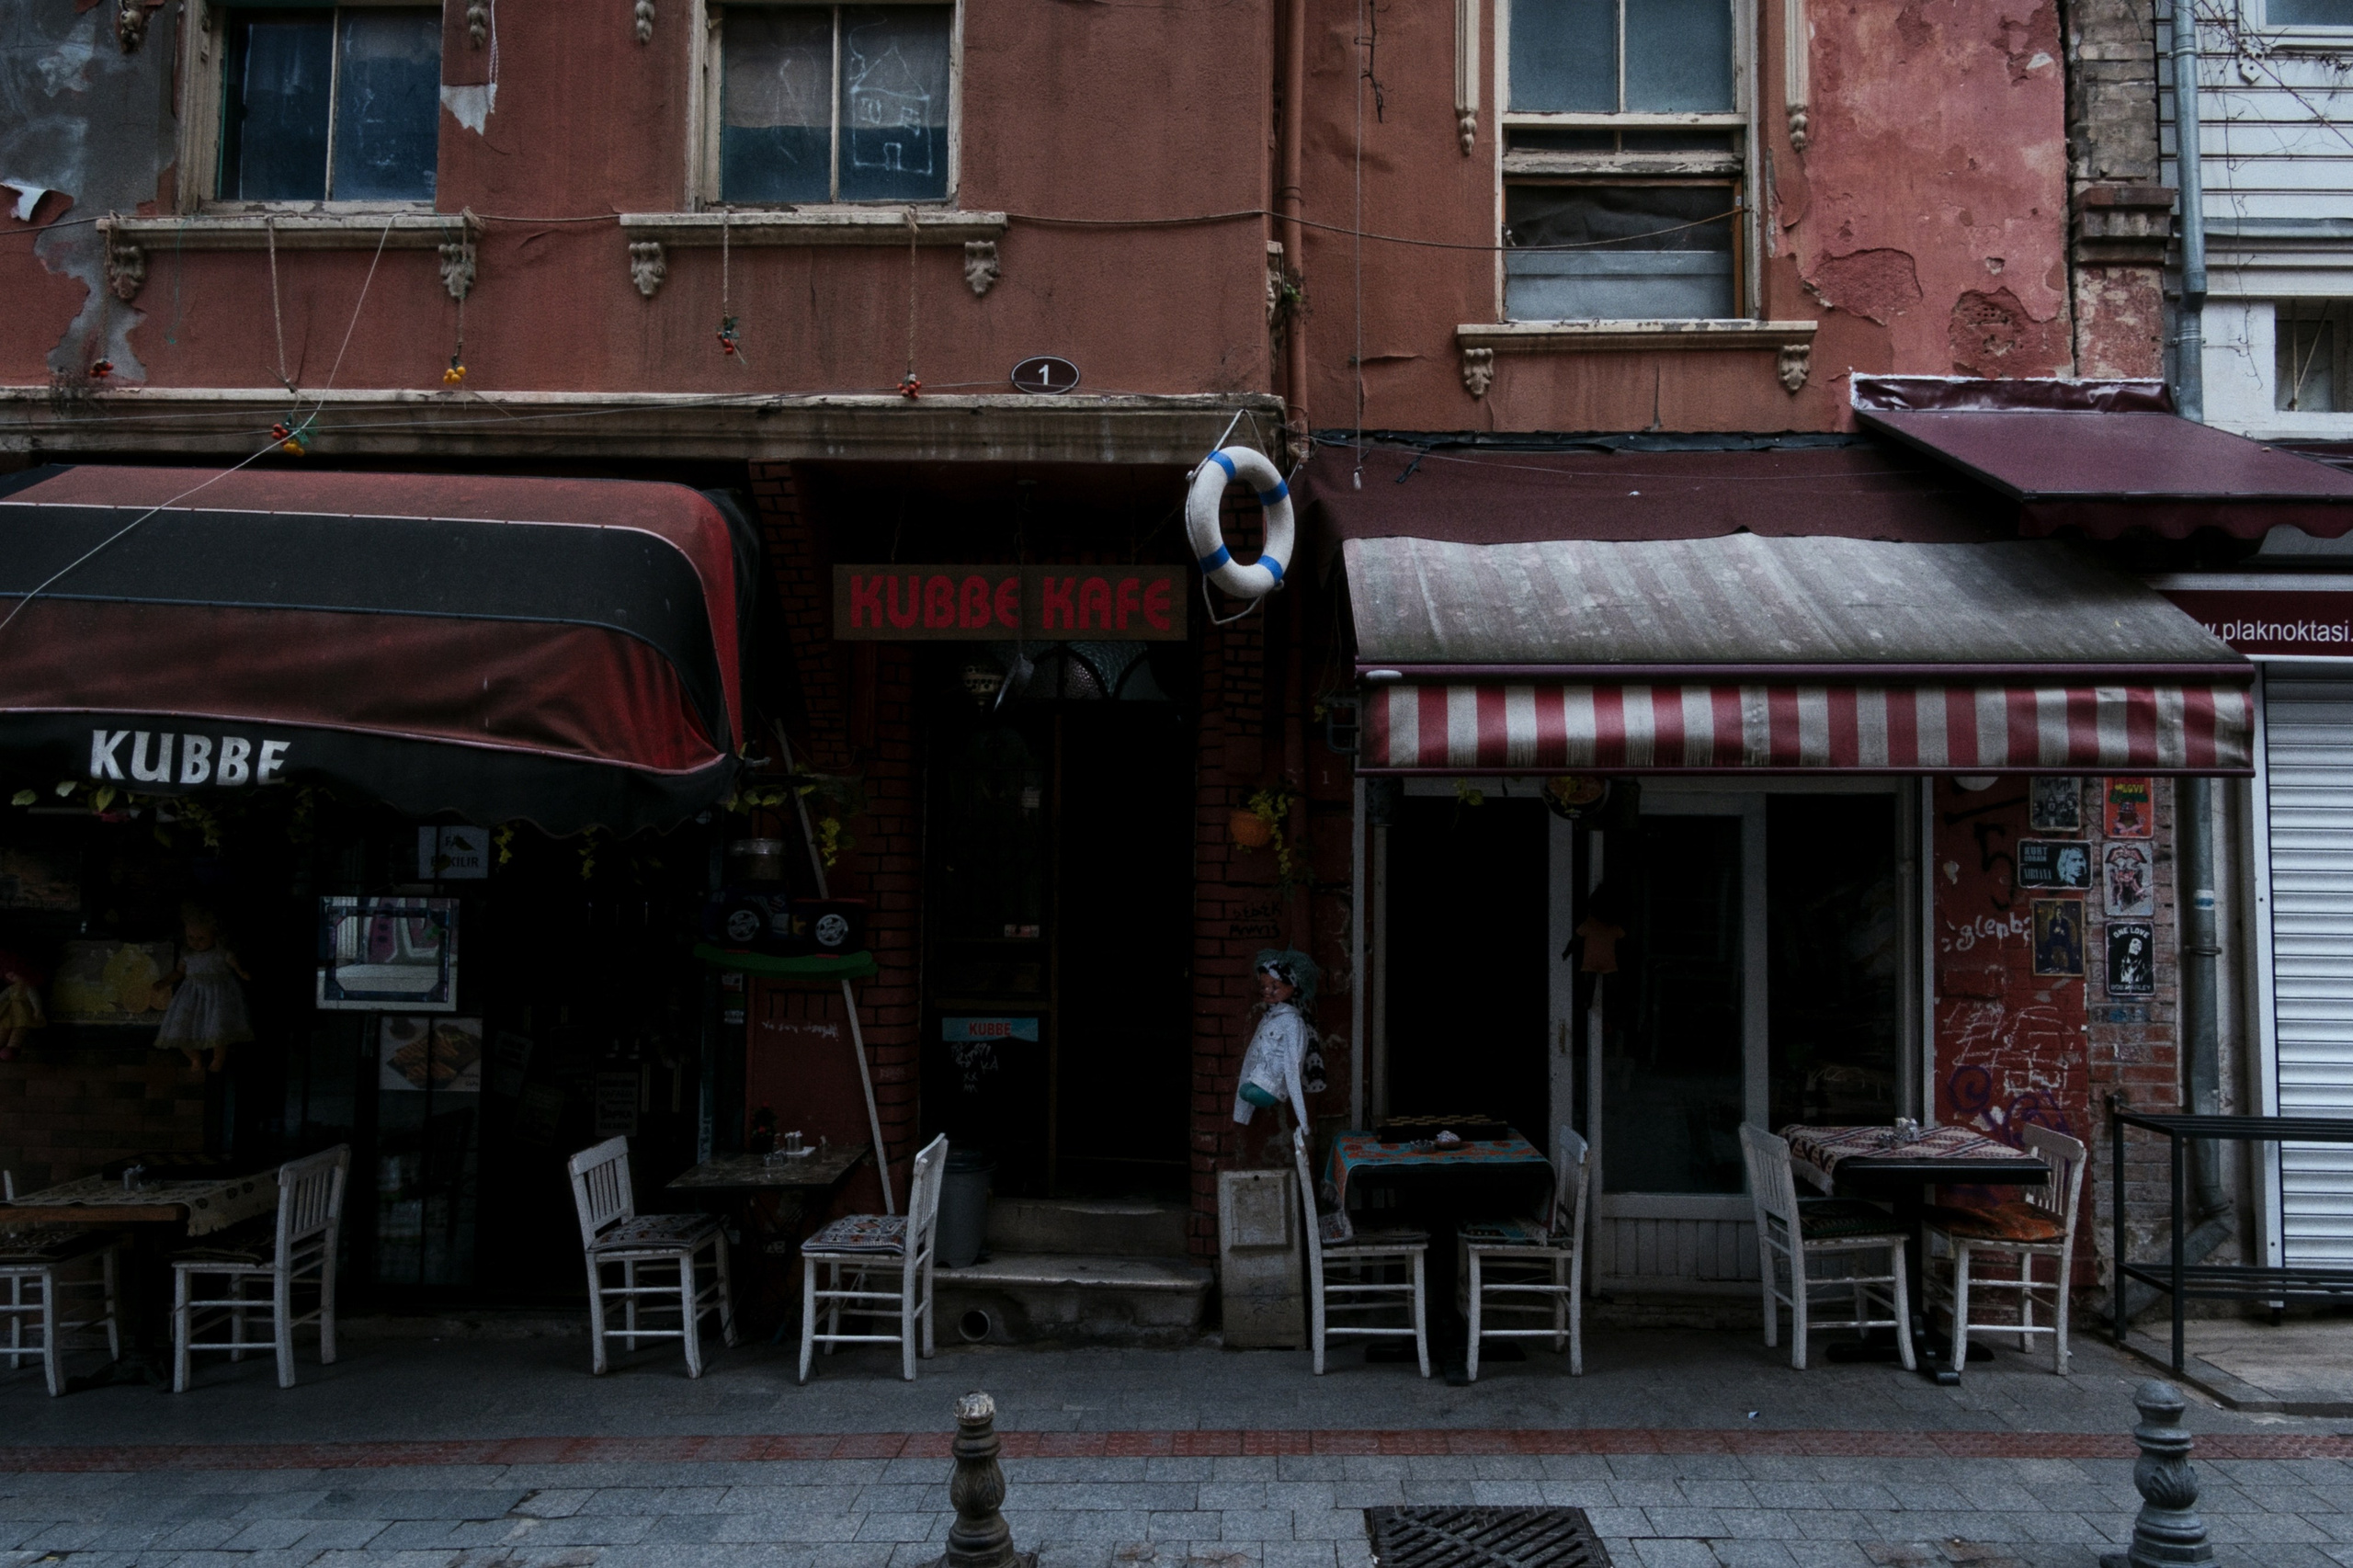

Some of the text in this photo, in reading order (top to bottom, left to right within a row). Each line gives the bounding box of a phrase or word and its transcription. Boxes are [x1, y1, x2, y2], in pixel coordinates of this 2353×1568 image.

[1038, 364, 1050, 386] 1
[850, 574, 1172, 631] KUBBE KAFE
[90, 729, 292, 787] KUBBE
[431, 856, 479, 868] BKILIR
[2112, 926, 2151, 939] ONE LOVE
[969, 1022, 1011, 1037] KUBBE
